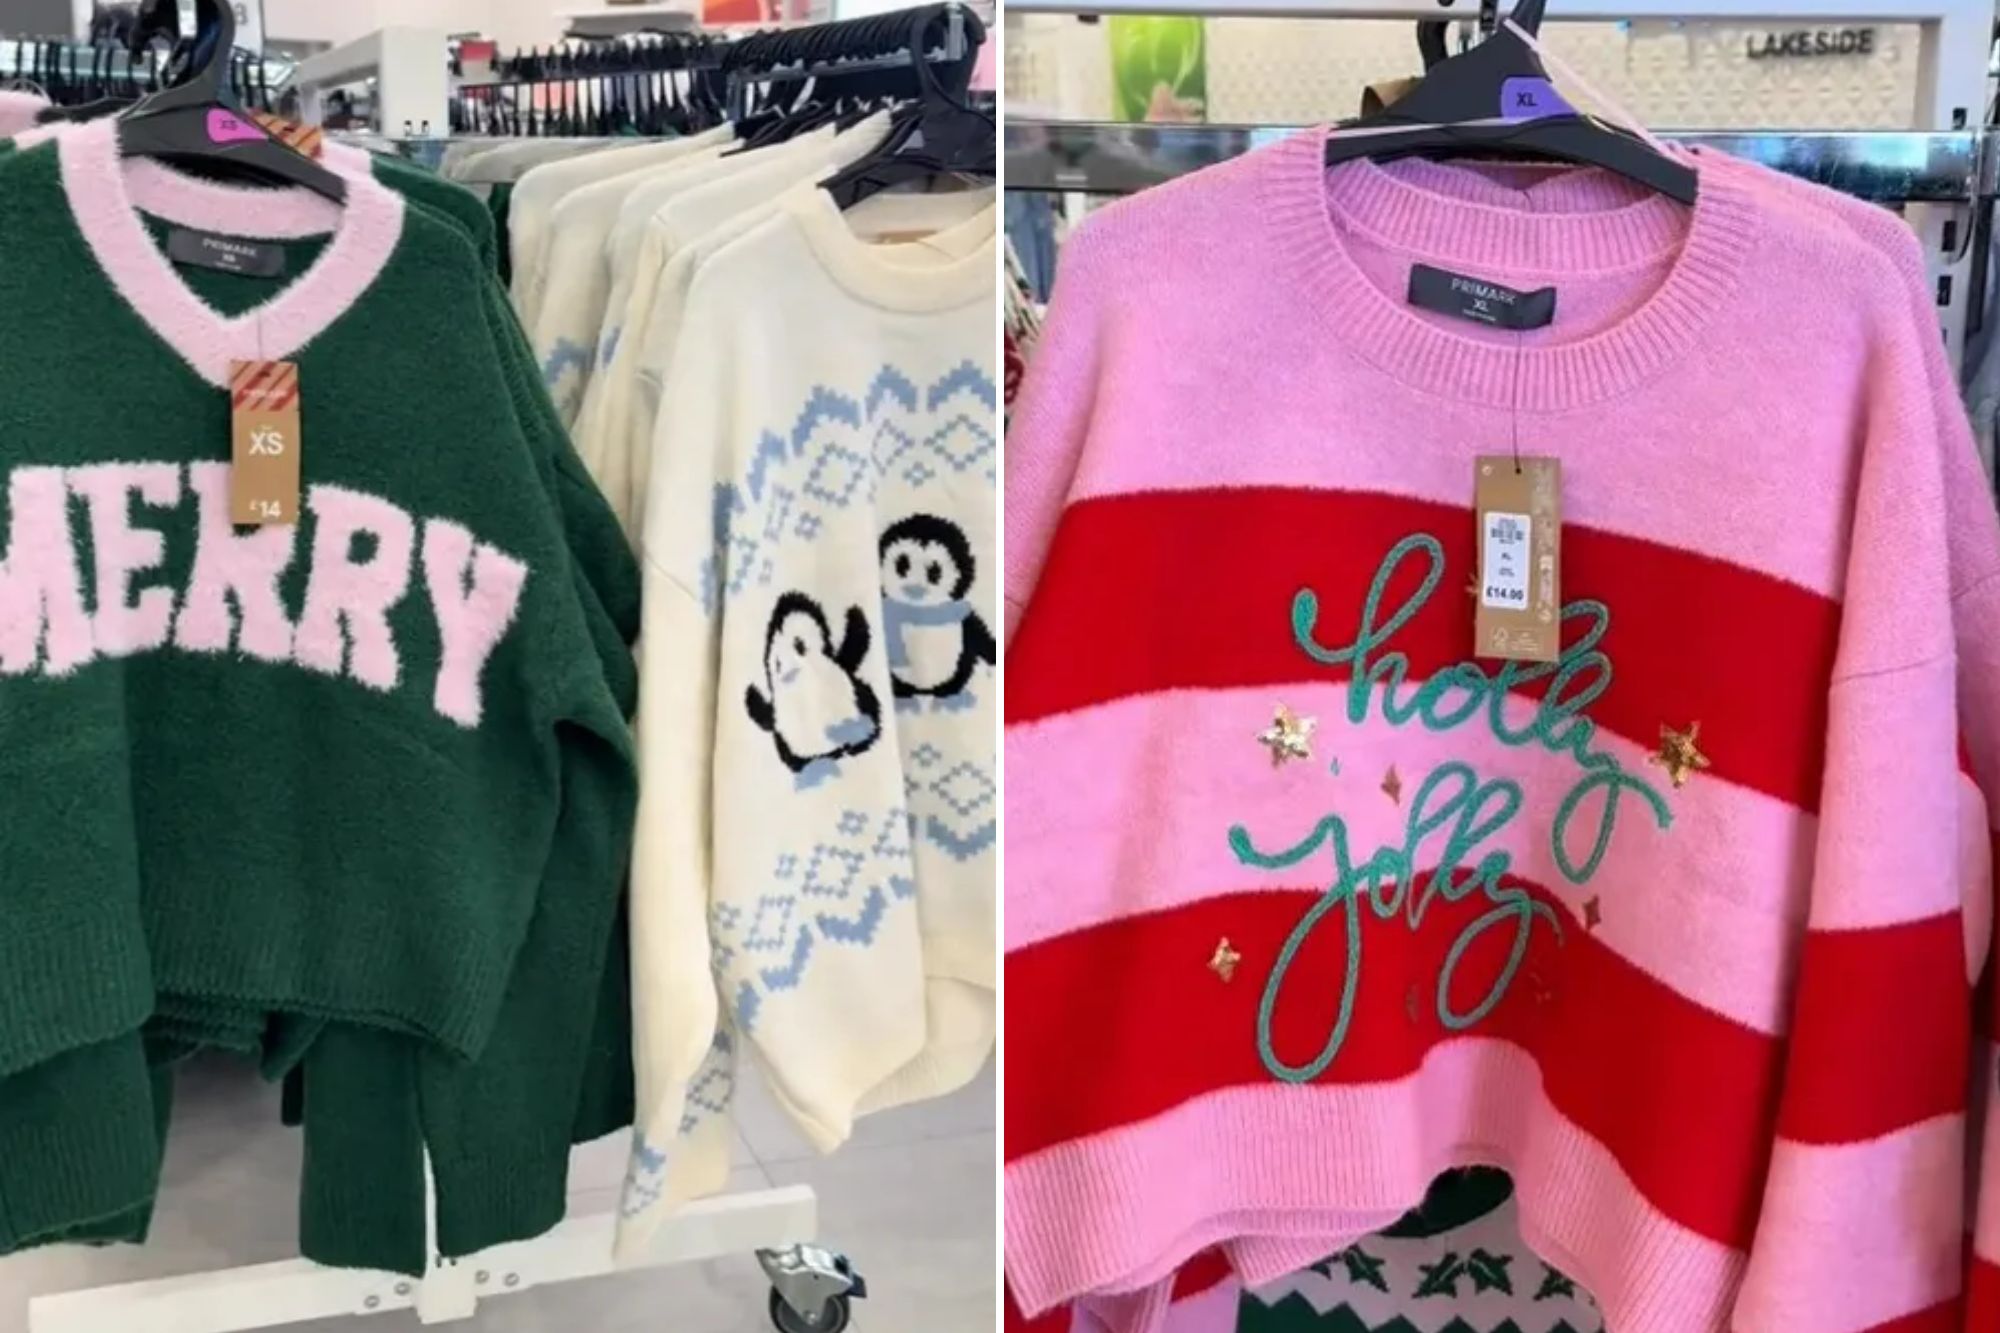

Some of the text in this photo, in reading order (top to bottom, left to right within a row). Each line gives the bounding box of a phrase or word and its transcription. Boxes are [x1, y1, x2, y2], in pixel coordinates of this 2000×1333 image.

[1746, 28, 1874, 59] LAKESIDE
[1516, 91, 1539, 107] XL
[202, 238, 257, 258] PRIMARK
[1451, 277, 1516, 305] PRIMARK
[1472, 298, 1490, 312] XL
[249, 431, 284, 456] XS
[249, 500, 282, 517] £14
[1486, 585, 1525, 601] £14.00
[1291, 533, 1675, 885] holly
[1228, 760, 1565, 1084] jolly
